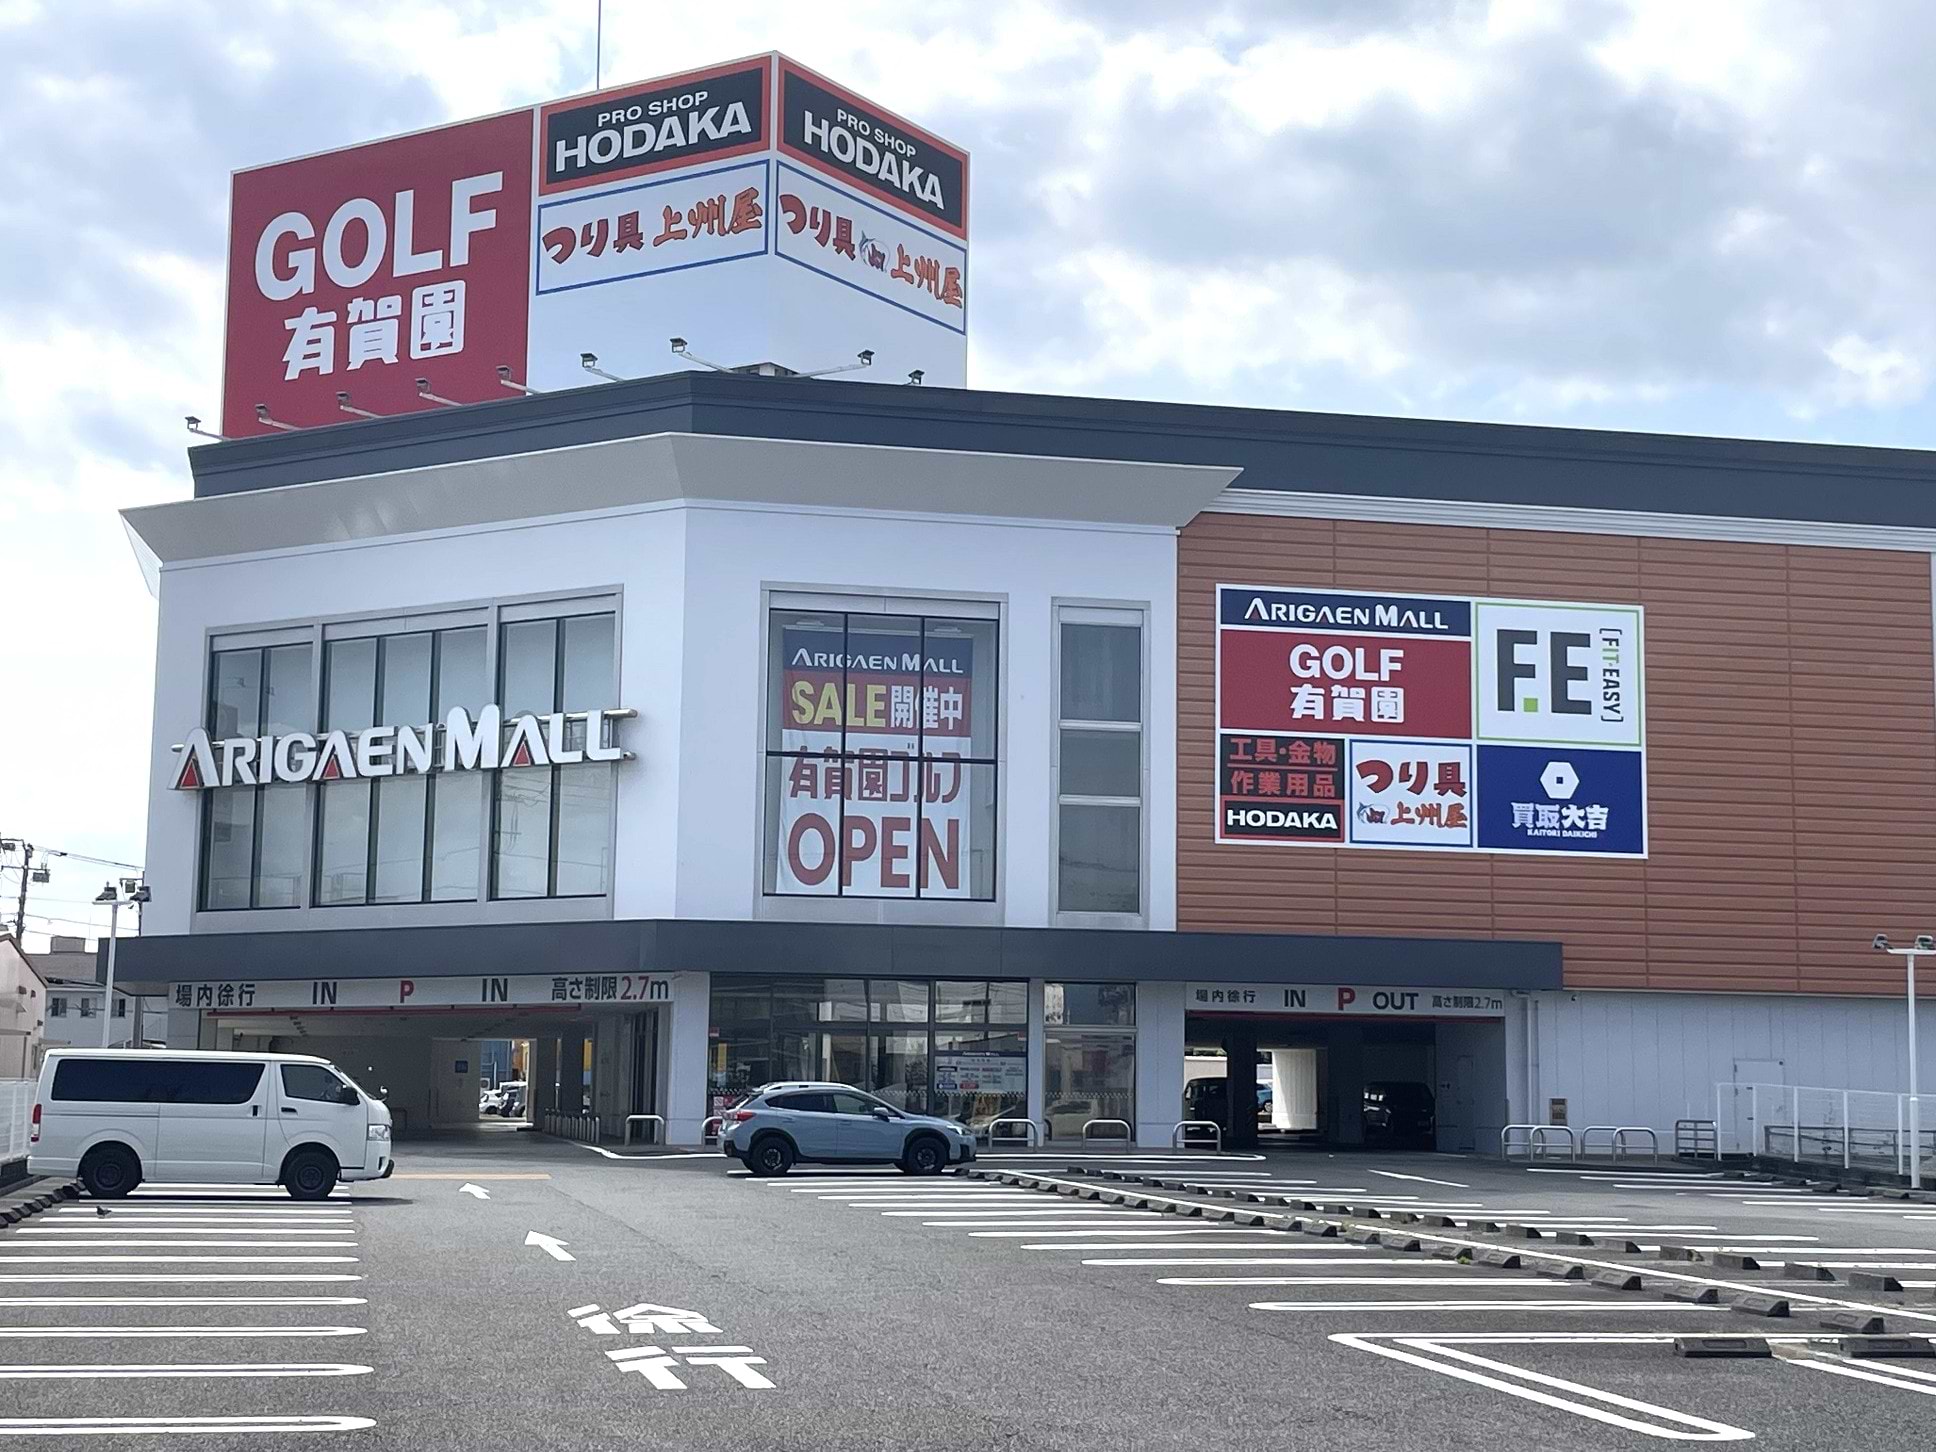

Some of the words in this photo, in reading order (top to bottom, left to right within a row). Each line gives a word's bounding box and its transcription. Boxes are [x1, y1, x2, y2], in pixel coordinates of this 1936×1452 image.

[598, 105, 642, 127] PRO
[648, 91, 709, 117] SHOP
[555, 101, 752, 173] HODAKA
[837, 108, 870, 137] PRO
[873, 127, 917, 158] SHOP
[803, 110, 945, 210] HODAKA
[255, 171, 503, 301] GOLF
[542, 210, 645, 264] つり具
[653, 187, 764, 247] 上州屋
[779, 193, 857, 261] つり具
[891, 243, 963, 309] 上州屋
[282, 279, 466, 381] 有賀園
[1375, 604, 1448, 629] MALL
[1289, 643, 1404, 682] GOLF
[1290, 684, 1404, 723] 有賀園
[444, 703, 623, 772] MALL
[1230, 770, 1336, 798] 作業用品
[1356, 759, 1467, 797] つり具
[1226, 809, 1338, 830] HODAKA
[1391, 801, 1467, 828] 上州屋
[1510, 802, 1609, 830] 買取大吉
[788, 812, 960, 890] OPEN
[176, 983, 256, 1007] 場内徐行
[312, 981, 338, 1005] IN
[400, 980, 414, 1004] P
[481, 978, 508, 1002] IN
[1284, 989, 1306, 1008] IN
[1338, 987, 1355, 1011] P
[1372, 991, 1419, 1010] OUT
